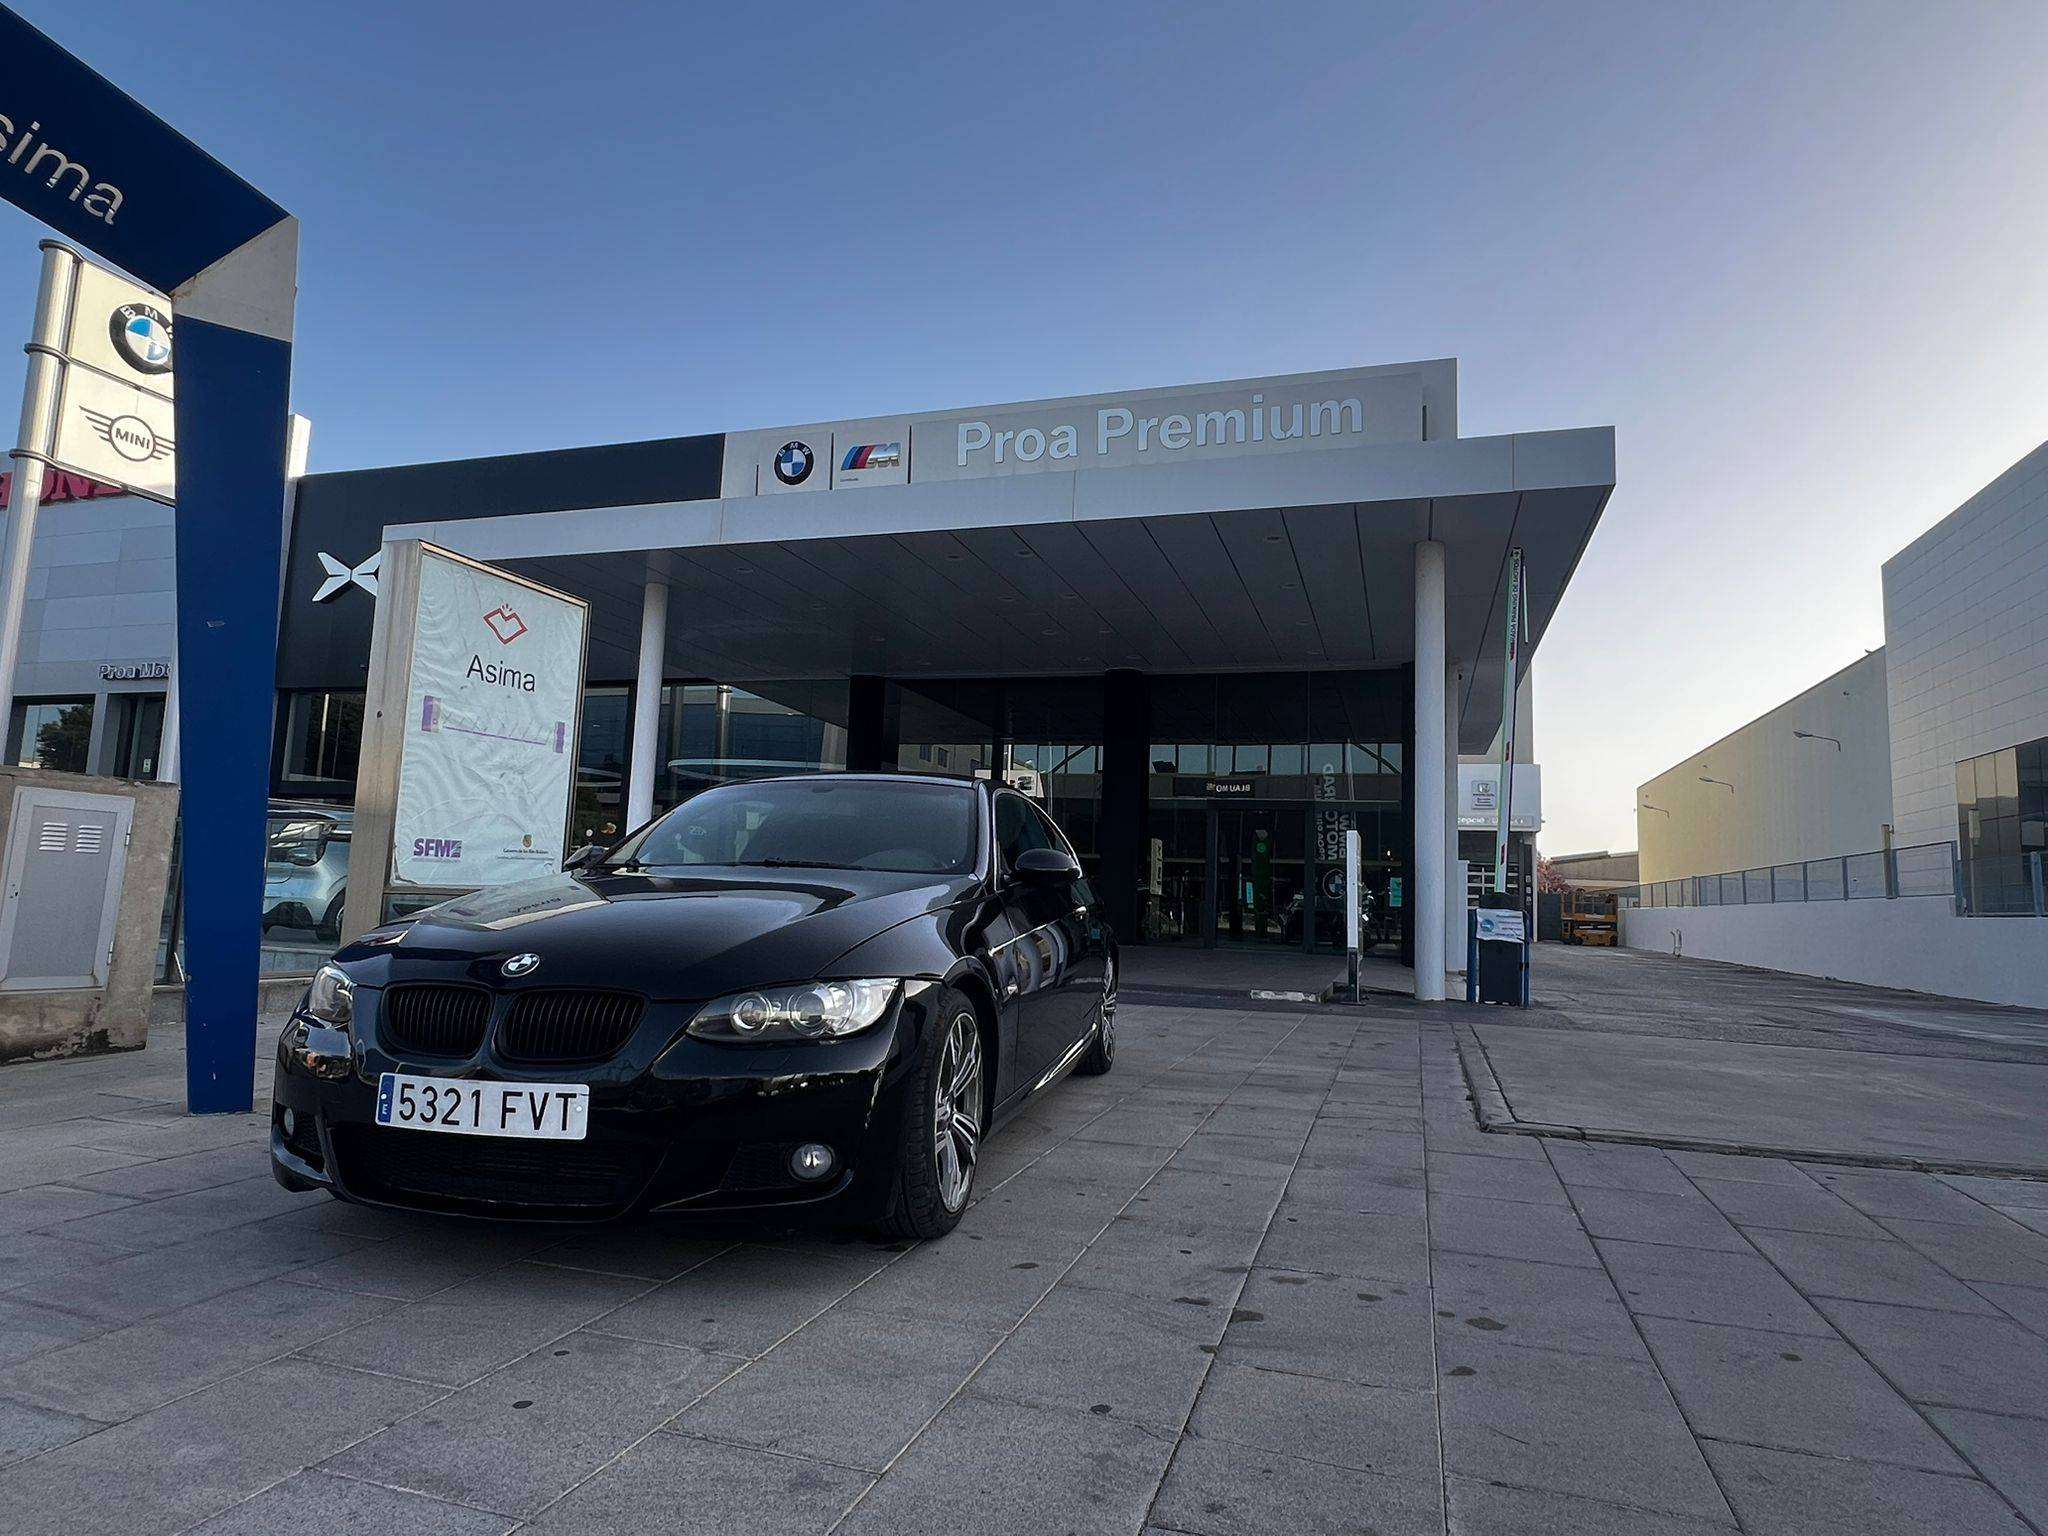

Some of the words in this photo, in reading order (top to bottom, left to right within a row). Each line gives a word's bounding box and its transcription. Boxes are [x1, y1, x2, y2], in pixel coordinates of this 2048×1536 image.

[115, 427, 150, 450] MINI
[957, 420, 1078, 466] Proa
[1097, 394, 1363, 455] Premium
[98, 664, 136, 680] Proa
[466, 654, 535, 692] Asima
[413, 837, 451, 858] SFM
[381, 1103, 388, 1115] E
[399, 1083, 481, 1128] 5321
[500, 1090, 577, 1131] FVT
